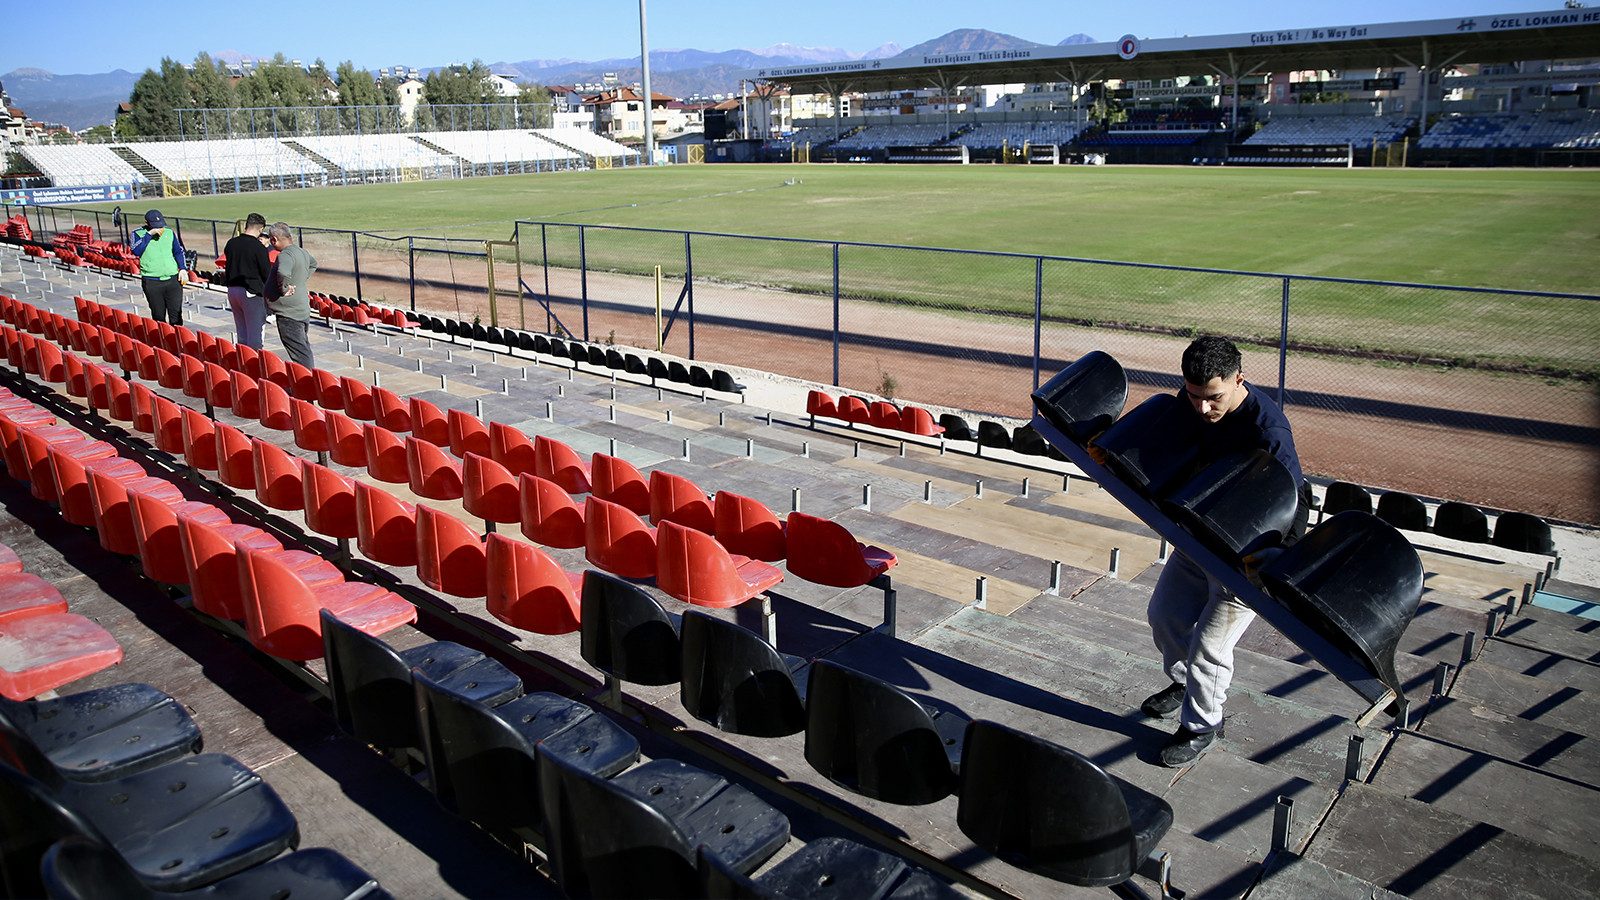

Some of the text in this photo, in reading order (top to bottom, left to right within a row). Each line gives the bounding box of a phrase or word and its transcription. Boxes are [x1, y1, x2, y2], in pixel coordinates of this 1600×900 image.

[1491, 18, 1521, 28] ÖZEL
[1525, 14, 1578, 26] LOKMAN
[1250, 33, 1274, 45] Çıkış
[1277, 32, 1293, 41] Yok
[1312, 29, 1324, 39] No
[1327, 29, 1347, 39] Way
[1350, 27, 1367, 37] Out
[979, 52, 993, 60] This
[994, 51, 1001, 59] is
